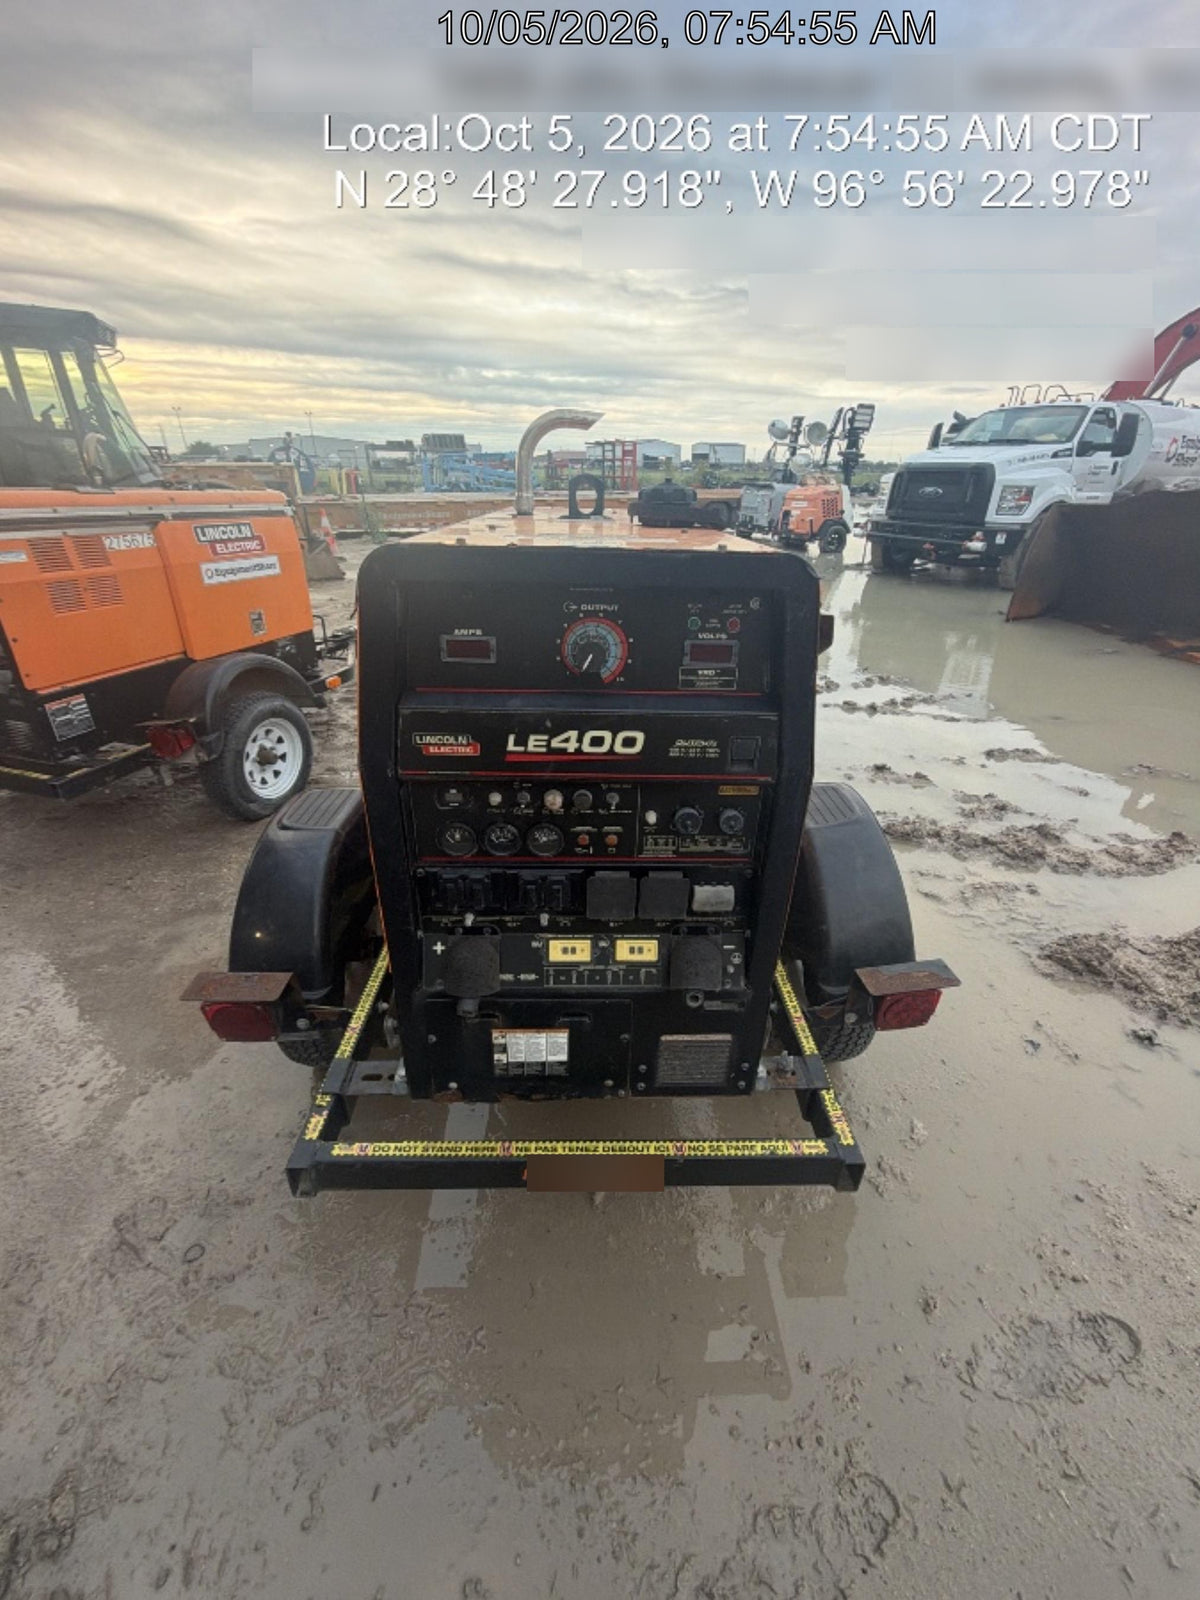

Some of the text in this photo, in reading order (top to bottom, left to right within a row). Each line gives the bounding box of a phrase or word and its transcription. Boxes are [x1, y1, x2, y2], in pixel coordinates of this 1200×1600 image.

[197, 525, 252, 541] LINCOLN
[216, 539, 263, 554] ELECTRIC
[580, 603, 619, 611] OUTPUT
[415, 735, 467, 745] LINCOLN
[506, 730, 645, 755] LE400
[429, 746, 474, 754] ELECTRIC
[372, 1144, 391, 1153] DO
[393, 1144, 420, 1153] NOT
[421, 1144, 462, 1153] STAND
[688, 1144, 706, 1153] NO
[709, 1144, 725, 1153] SE
